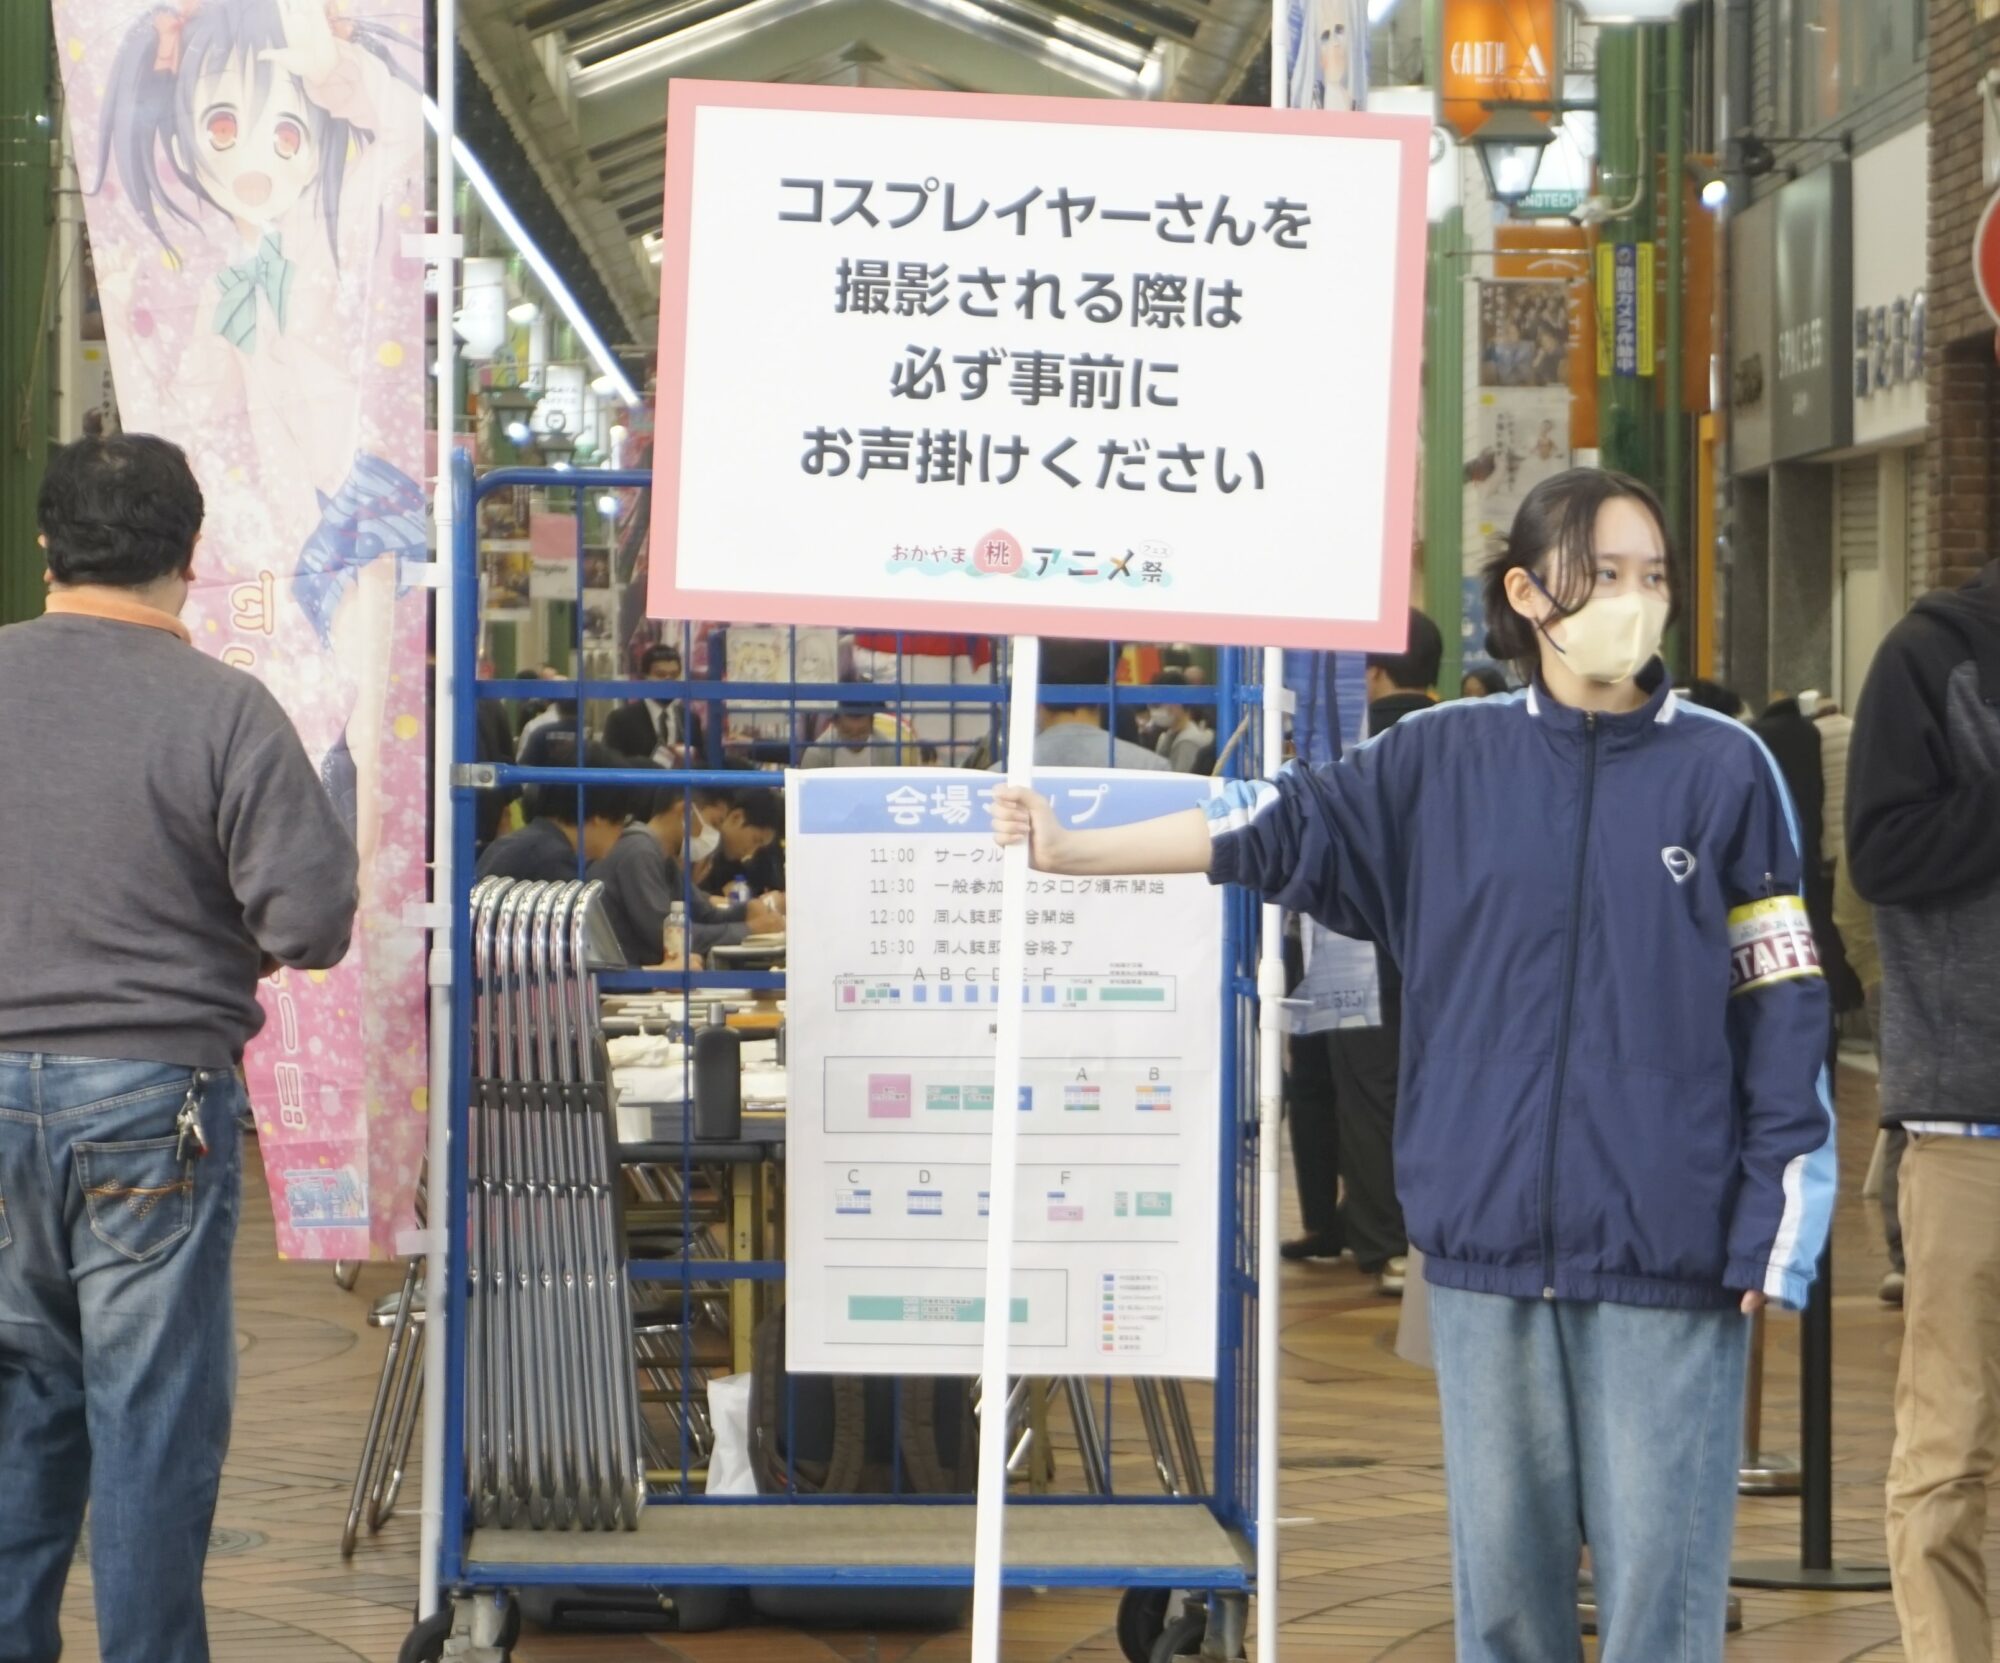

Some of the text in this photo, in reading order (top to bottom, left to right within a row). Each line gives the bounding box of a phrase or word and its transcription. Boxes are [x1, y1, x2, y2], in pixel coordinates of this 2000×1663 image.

[779, 177, 1311, 250] コスプレイヤーさんを
[835, 258, 1243, 329] 撮影される際は
[890, 344, 1179, 410] 必ず事前に
[800, 427, 1264, 494] お声掛けください
[885, 783, 1109, 826] 会場プ
[870, 848, 914, 864] 11:00
[870, 878, 914, 895] 11:30
[870, 909, 1076, 926] 12:00 同人誌即会開始
[870, 940, 1074, 956] 15:30 同人誌即会終了
[913, 967, 926, 981] A
[940, 967, 951, 981] B
[964, 967, 977, 981] C
[1043, 967, 1054, 981] F
[1075, 1067, 1160, 1081] A B
[847, 1169, 1070, 1185] C D F
